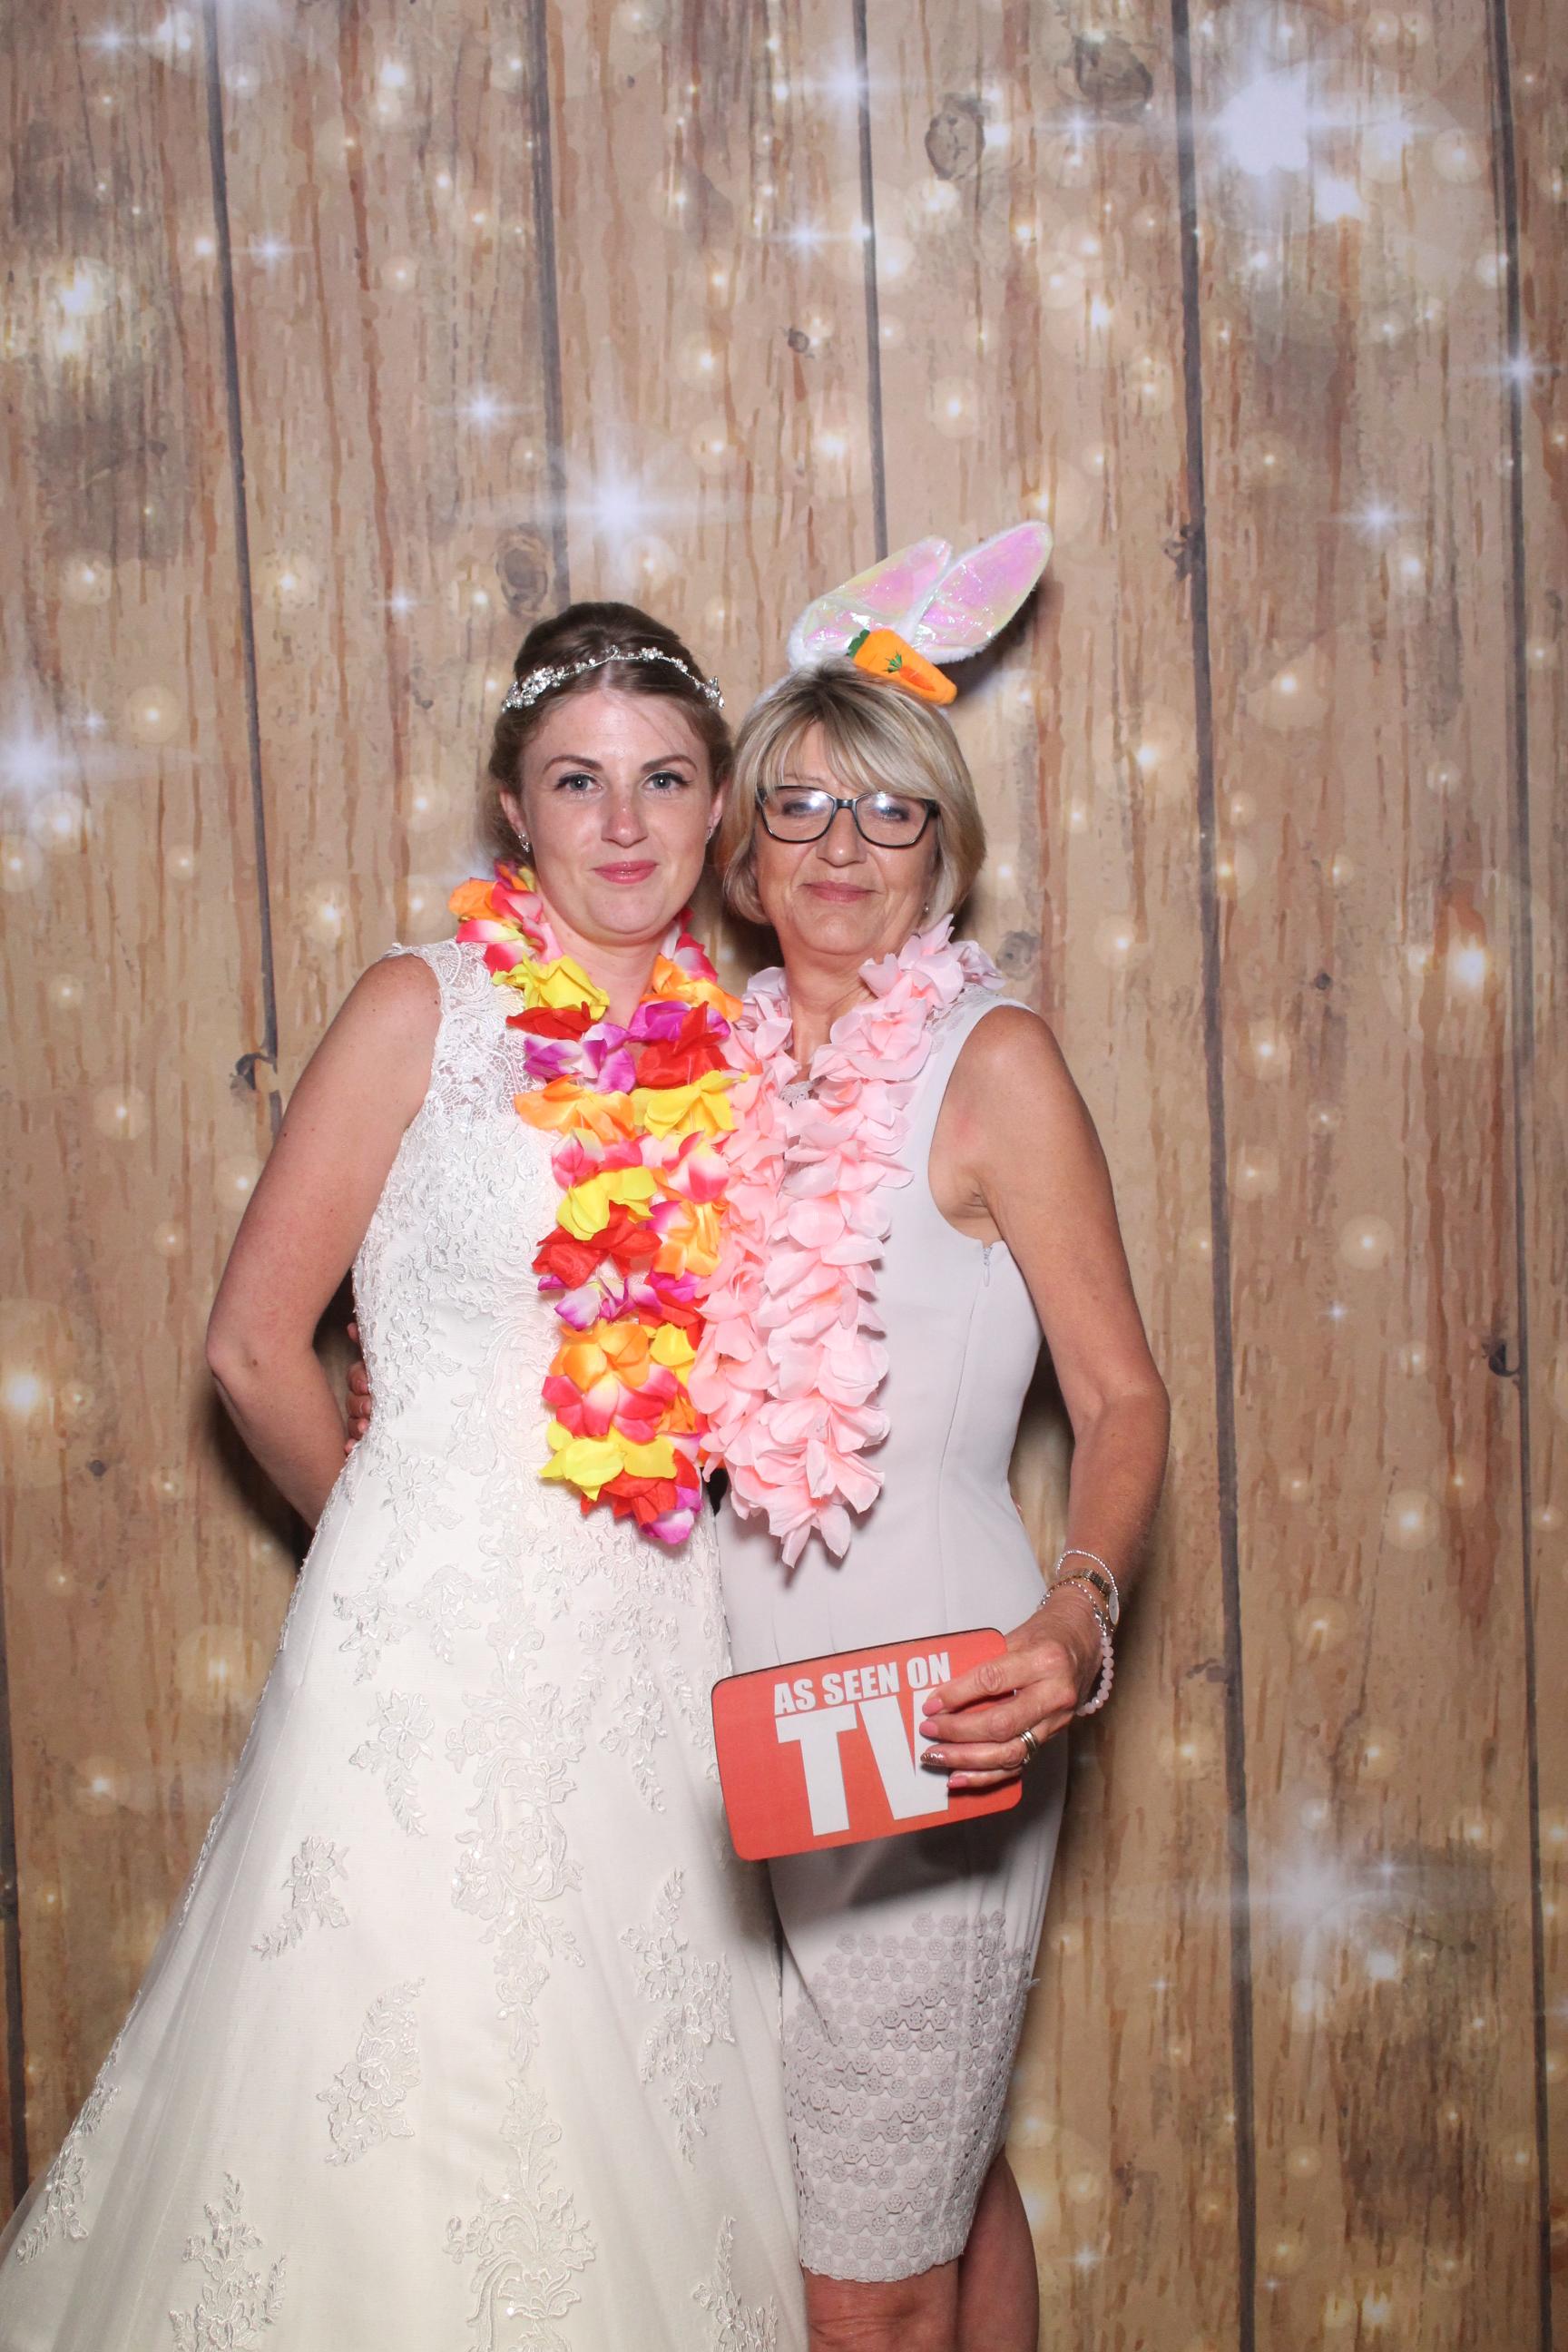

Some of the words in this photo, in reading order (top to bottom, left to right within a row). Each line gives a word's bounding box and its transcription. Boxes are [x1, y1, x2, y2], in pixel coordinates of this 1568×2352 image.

[774, 1679, 816, 1716] AS
[821, 1661, 900, 1706] SEEN
[906, 1651, 951, 1690] ON
[775, 1687, 949, 1837] TV
